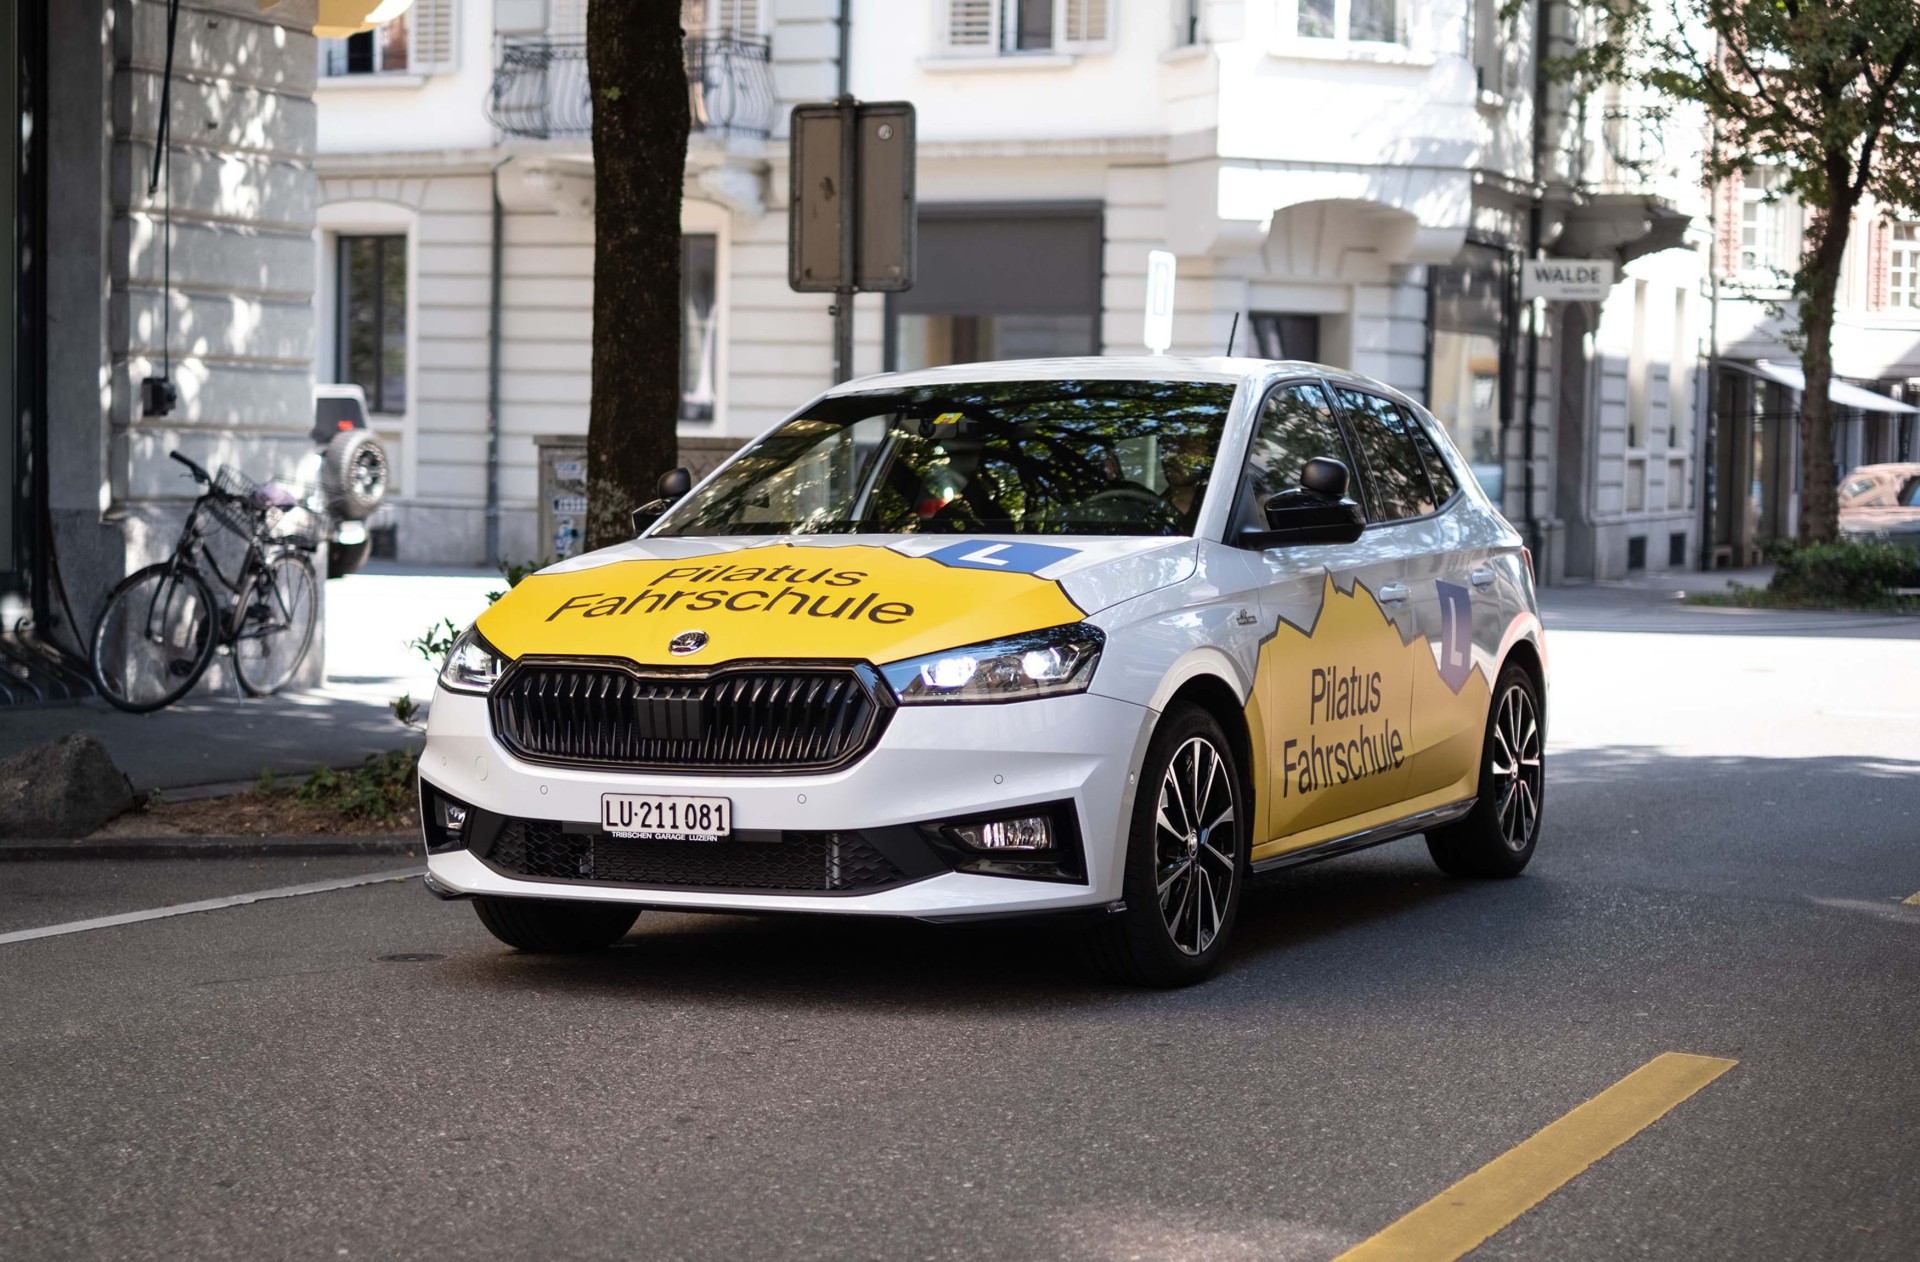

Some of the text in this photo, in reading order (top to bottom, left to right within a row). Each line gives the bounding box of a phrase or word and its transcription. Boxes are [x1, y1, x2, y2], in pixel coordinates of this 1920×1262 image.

[1535, 266, 1602, 284] WALDE
[957, 543, 1014, 566] L
[648, 565, 869, 587] Pilatus
[545, 587, 915, 624] Fahrschule
[1448, 596, 1464, 667] L
[1310, 666, 1382, 725] Pilatus
[1283, 718, 1405, 798] Fahrschule
[612, 831, 718, 842] TRIBSCHEN GARAGE LUZERN
